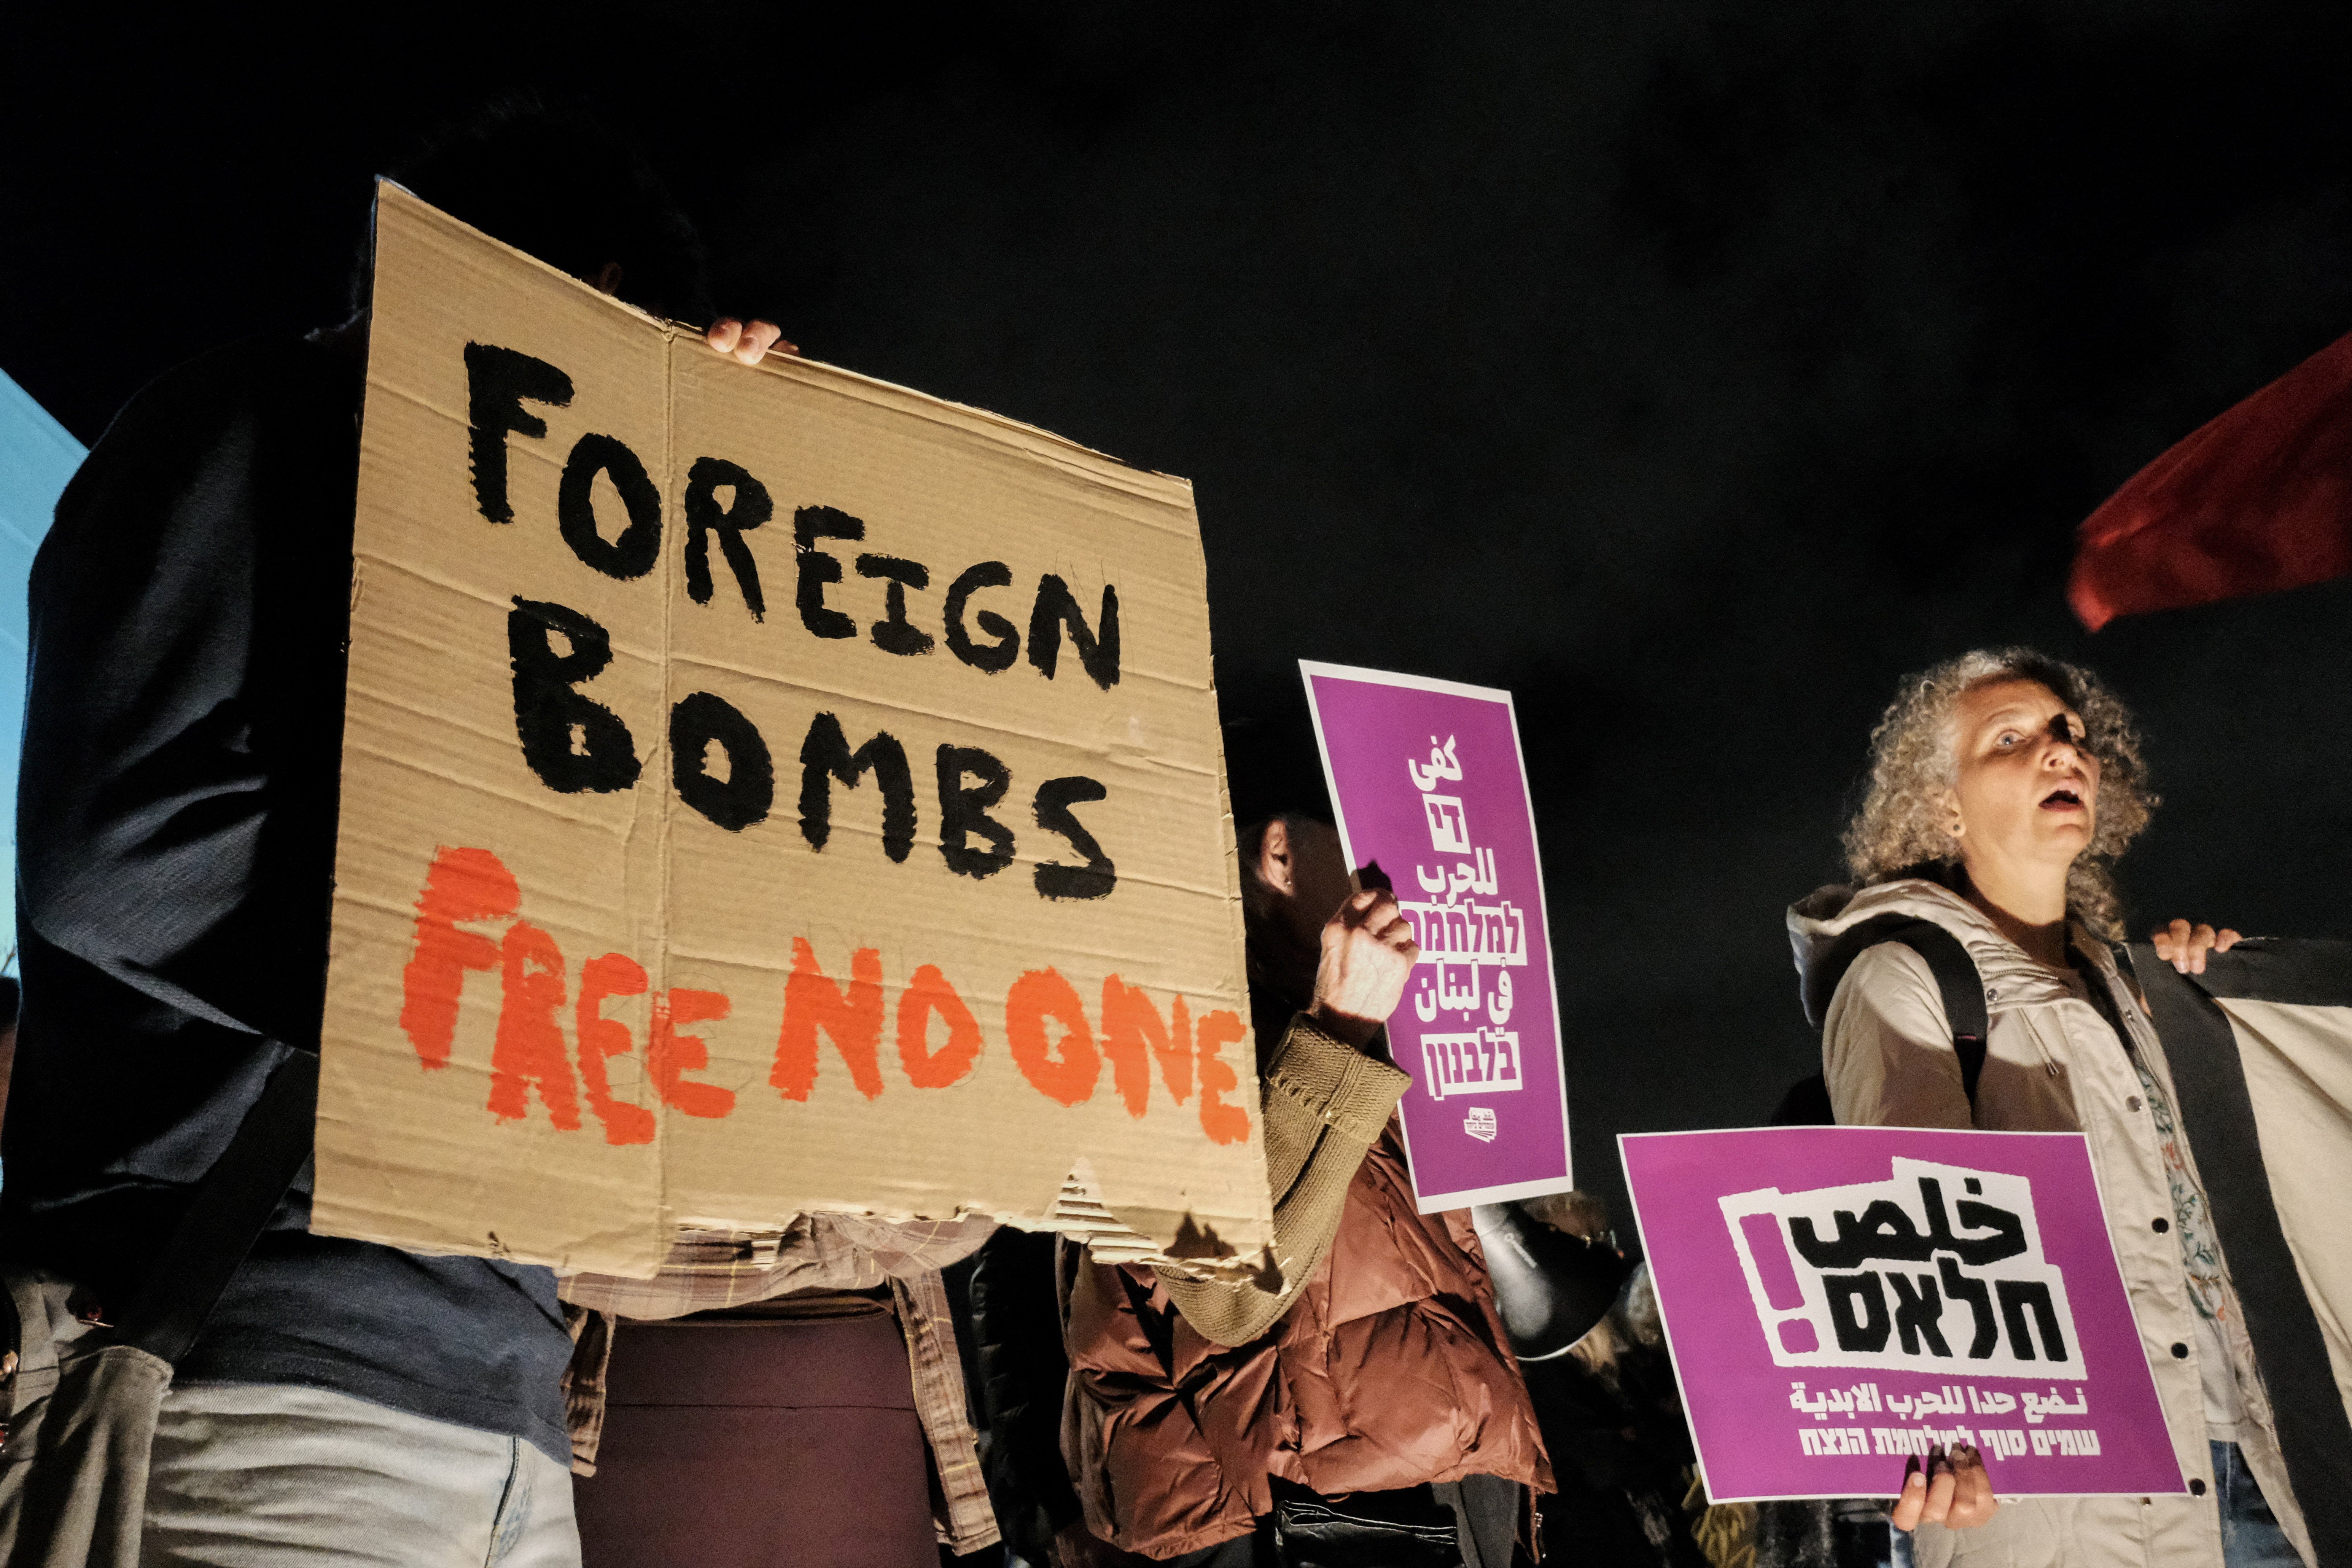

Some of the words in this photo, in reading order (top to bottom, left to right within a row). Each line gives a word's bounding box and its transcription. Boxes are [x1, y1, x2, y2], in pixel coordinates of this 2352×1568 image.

[464, 340, 1122, 692] FOREIGN
[508, 593, 1117, 902] BOMBS
[1408, 734, 1463, 791] كفى
[1428, 802, 1463, 843] די
[1416, 847, 1498, 909] للحرب
[399, 844, 736, 1146] FREE
[769, 934, 986, 1103] NO
[1005, 966, 1254, 1146] ONE
[1415, 958, 1480, 1022] لبنان
[1488, 957, 1513, 1036] في
[1426, 1029, 1517, 1097] בלבנון
[1789, 1382, 1883, 1420] الابدية
[1886, 1385, 1966, 1420] للحرب
[1967, 1386, 2017, 1414] حدا
[1798, 1428, 1870, 1455] הנצח
[1979, 1429, 2027, 1461] סוף
[2028, 1429, 2101, 1456] שמים
